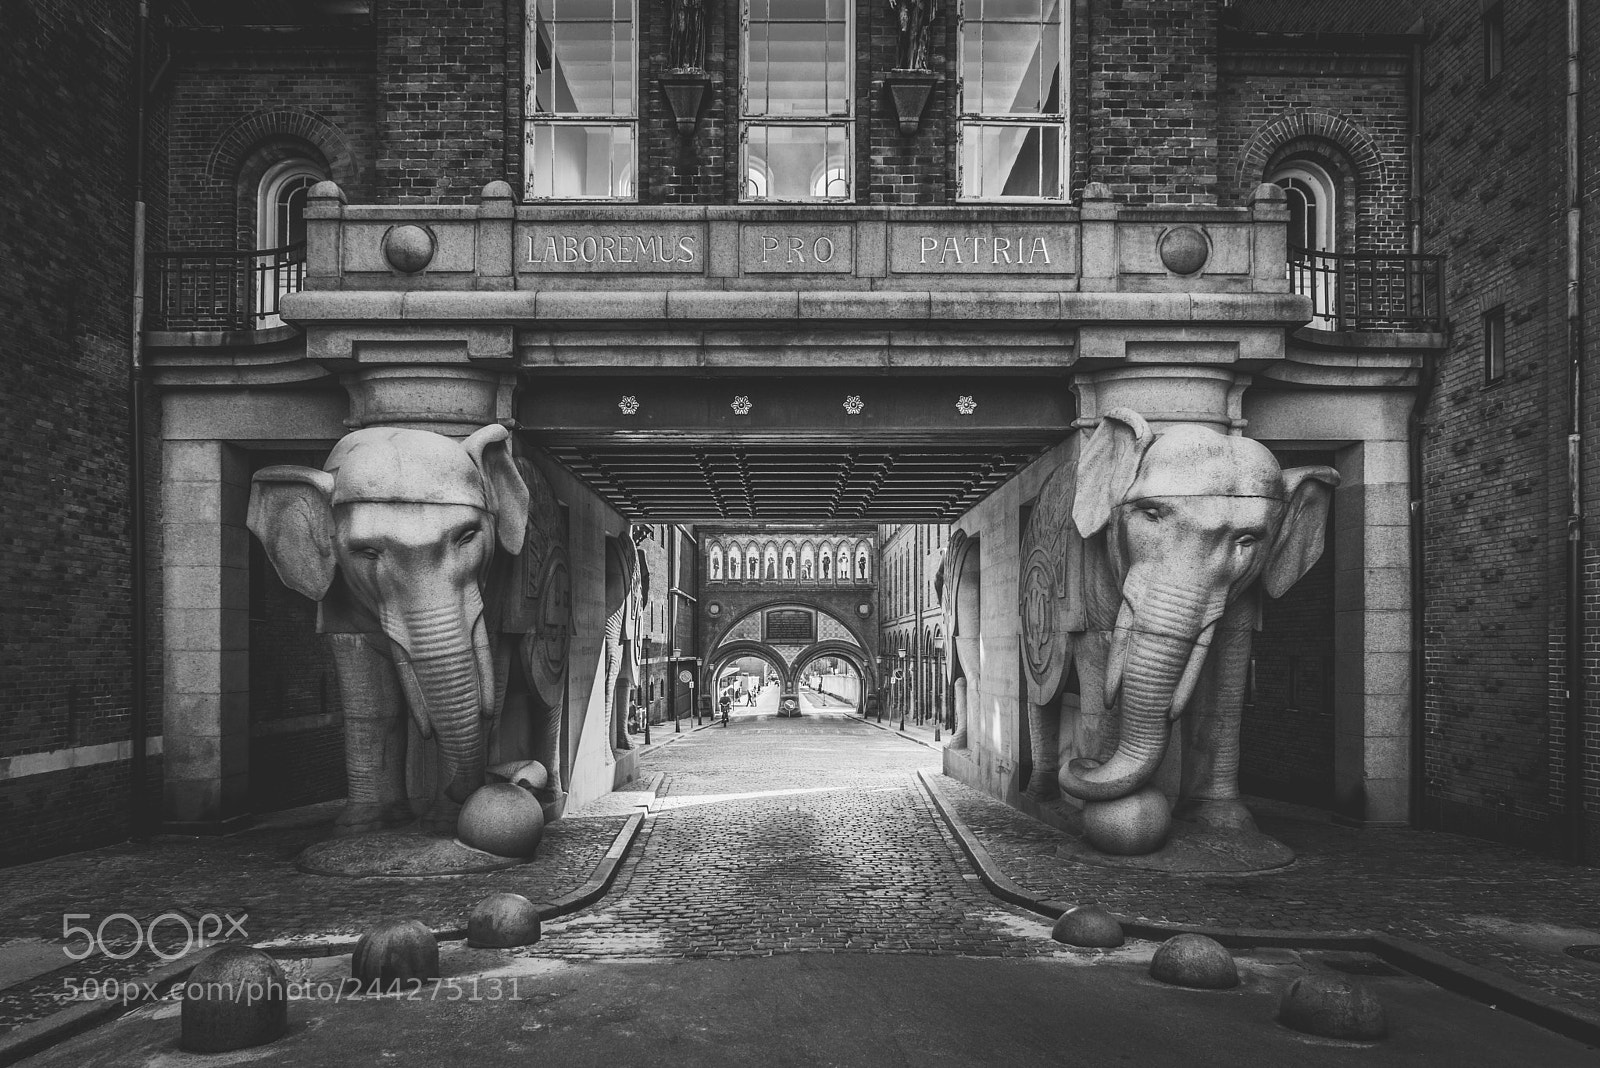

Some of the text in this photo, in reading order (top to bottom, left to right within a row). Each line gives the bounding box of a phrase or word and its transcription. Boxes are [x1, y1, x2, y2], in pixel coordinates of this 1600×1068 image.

[527, 235, 1051, 265] LABOREMUS PRO PATRIA
